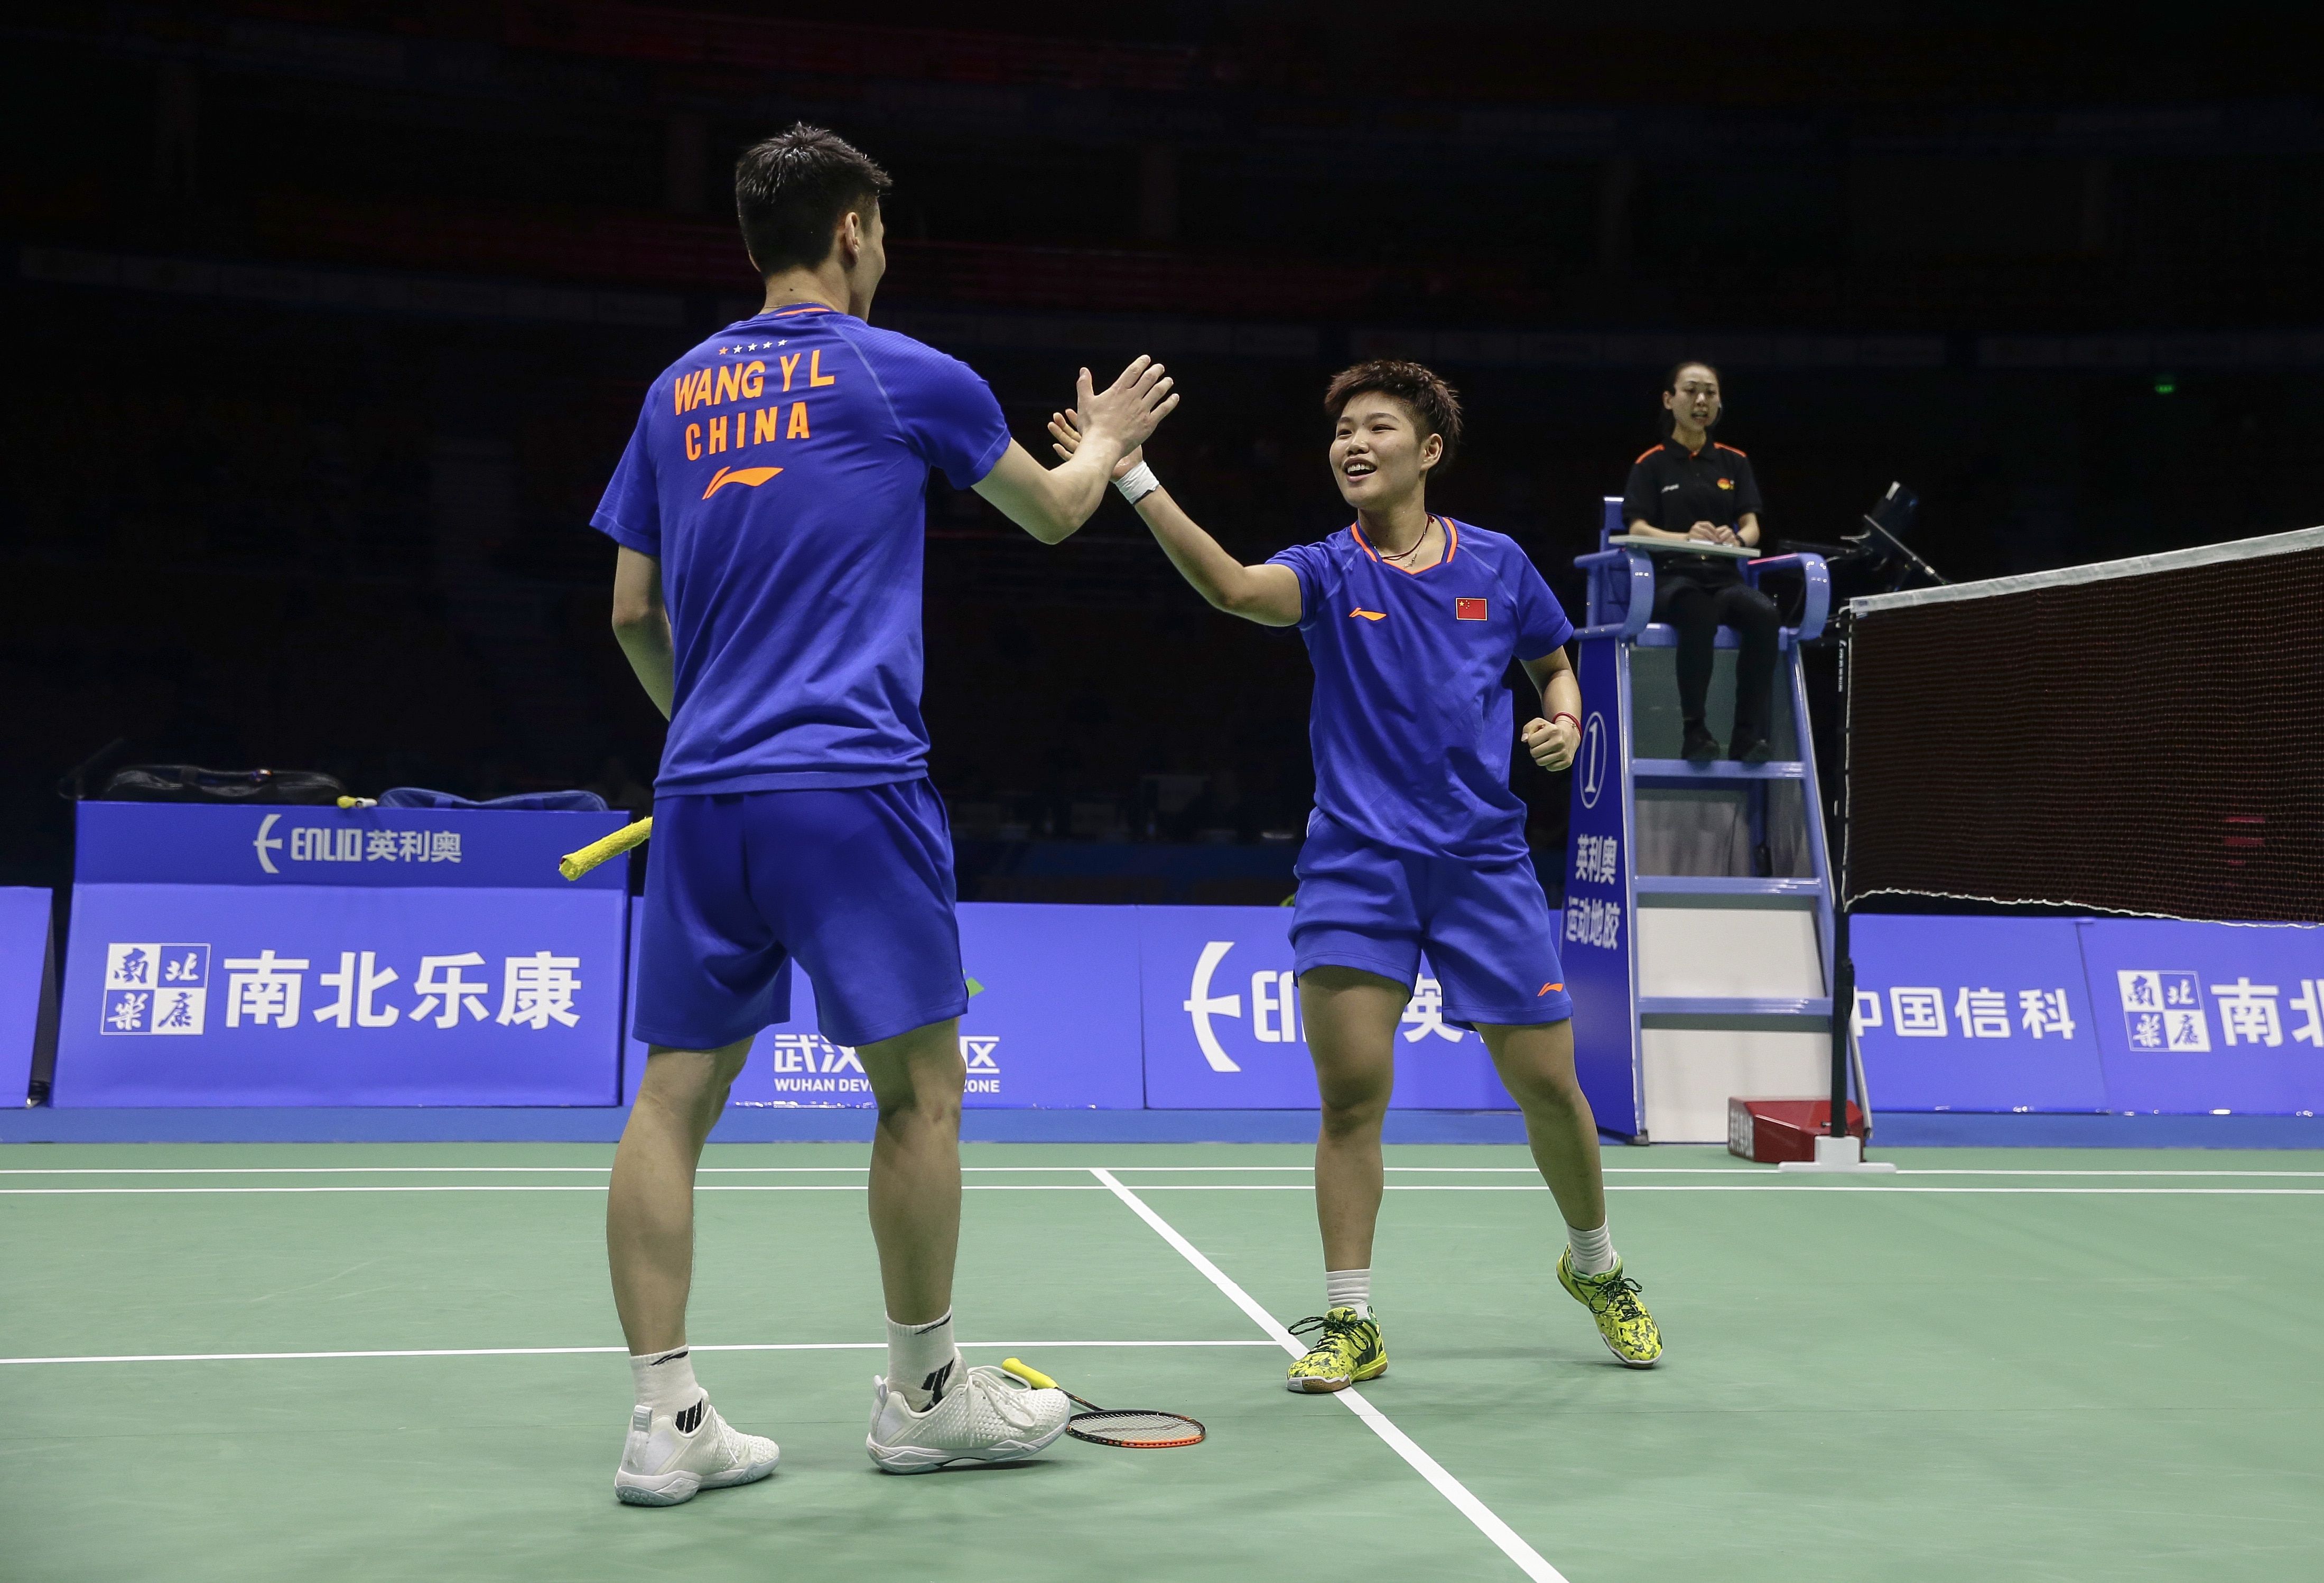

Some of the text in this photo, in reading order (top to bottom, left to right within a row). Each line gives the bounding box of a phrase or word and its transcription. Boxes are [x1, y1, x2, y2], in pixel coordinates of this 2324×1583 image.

[674, 360, 765, 416] WANG
[685, 402, 810, 461] CHINA
[291, 827, 462, 863] ENLIO 英利奥
[1575, 834, 1617, 885] 英利奥
[1566, 896, 1621, 950] 运动地胶
[223, 949, 582, 1030] 南北乐康
[774, 1078, 835, 1092] WUHAN
